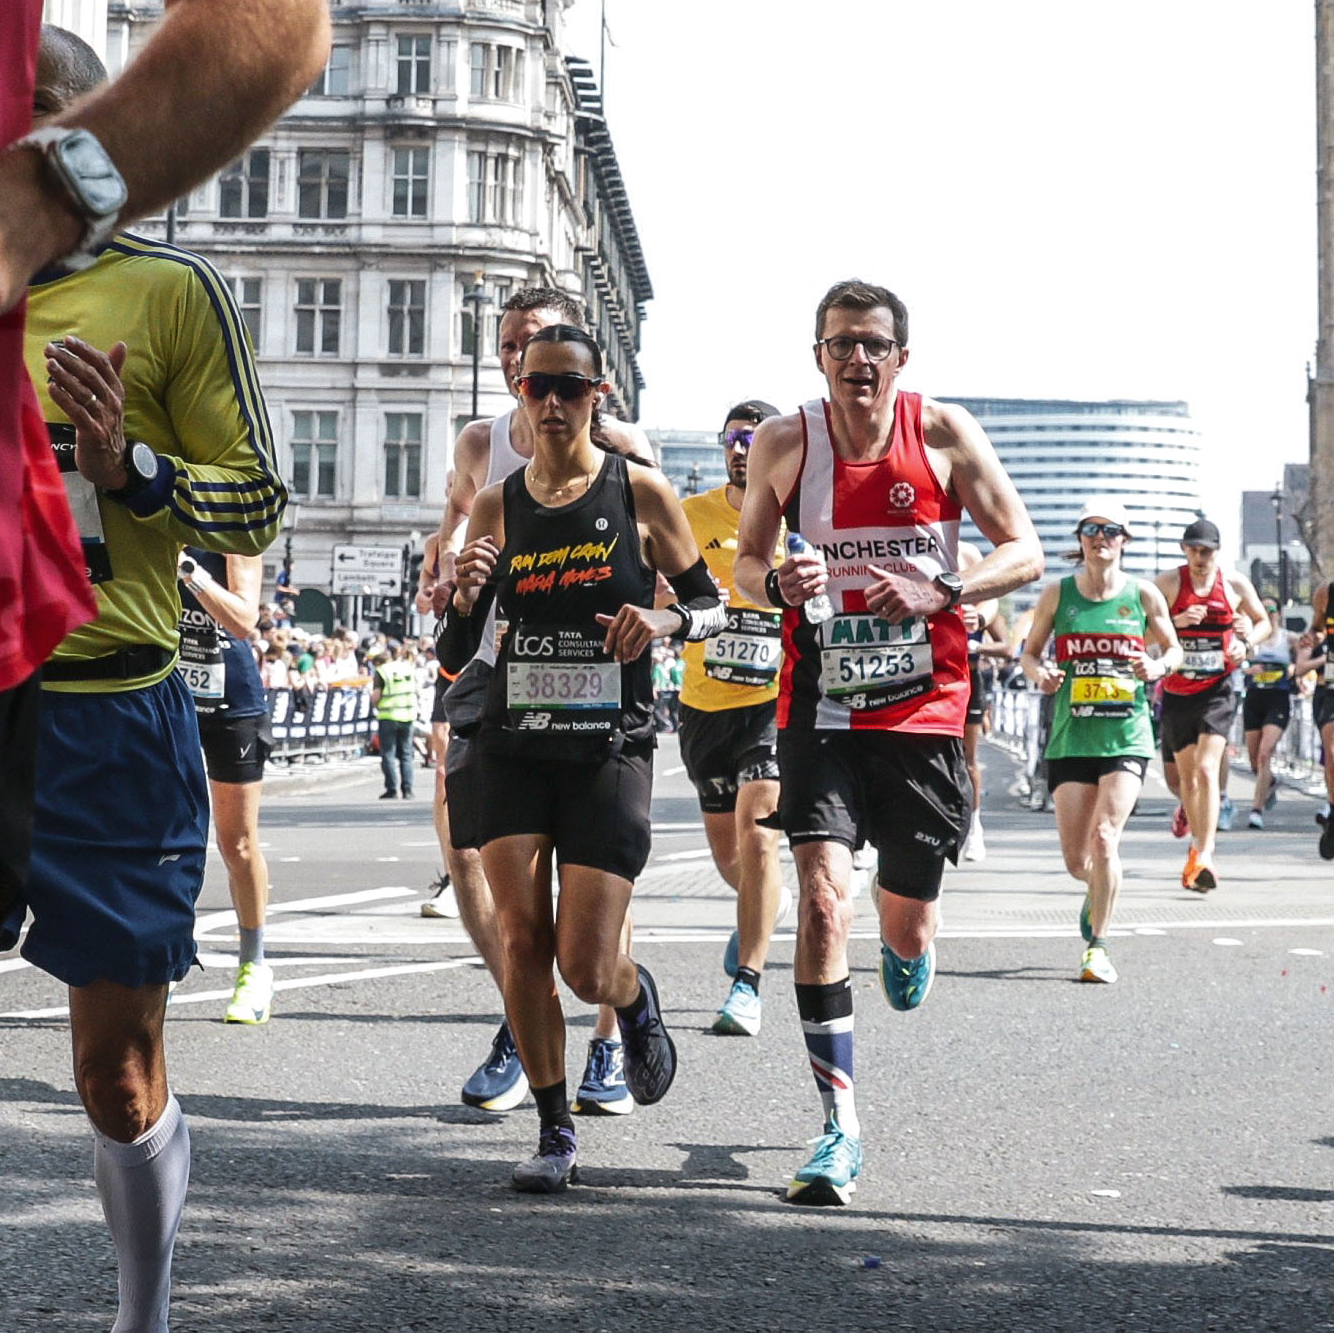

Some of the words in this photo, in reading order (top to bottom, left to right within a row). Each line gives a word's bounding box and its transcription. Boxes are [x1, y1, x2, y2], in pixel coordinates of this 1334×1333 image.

[817, 536, 939, 562] NCHESTER
[887, 562, 917, 574] CLUB
[558, 631, 582, 639] TATA
[831, 616, 916, 644] MATT
[514, 631, 554, 656] tcs
[557, 640, 604, 648] CONSULTAN
[557, 649, 595, 657] SERVICES
[716, 638, 769, 663] 51270
[180, 667, 210, 690] 752
[840, 653, 915, 682] 51253
[526, 672, 603, 699] 38329
[887, 685, 924, 702] balance
[551, 721, 571, 731] new
[572, 720, 611, 731] balance
